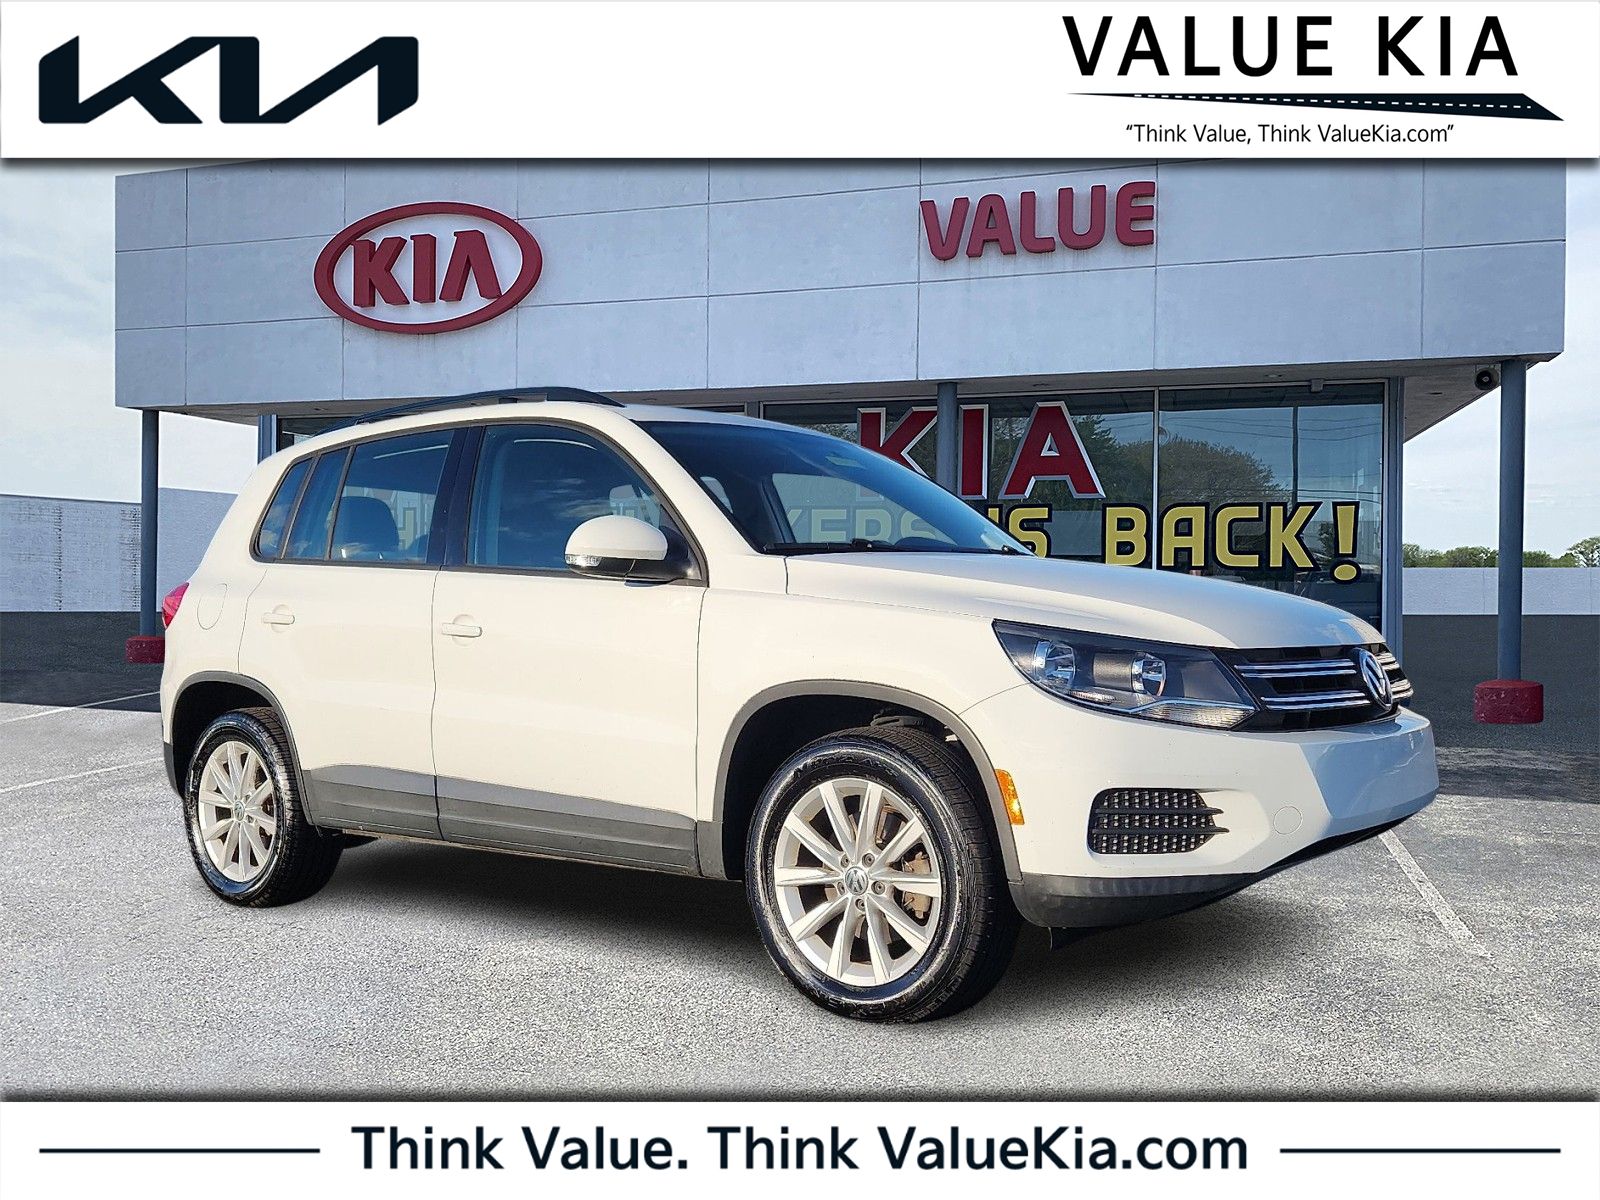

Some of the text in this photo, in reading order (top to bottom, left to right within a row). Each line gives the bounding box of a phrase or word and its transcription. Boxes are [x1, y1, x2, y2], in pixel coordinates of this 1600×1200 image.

[919, 181, 1156, 261] VALUE
[350, 229, 503, 308] KIA
[857, 401, 1106, 500] KIA
[1102, 502, 1362, 584] BACK!
